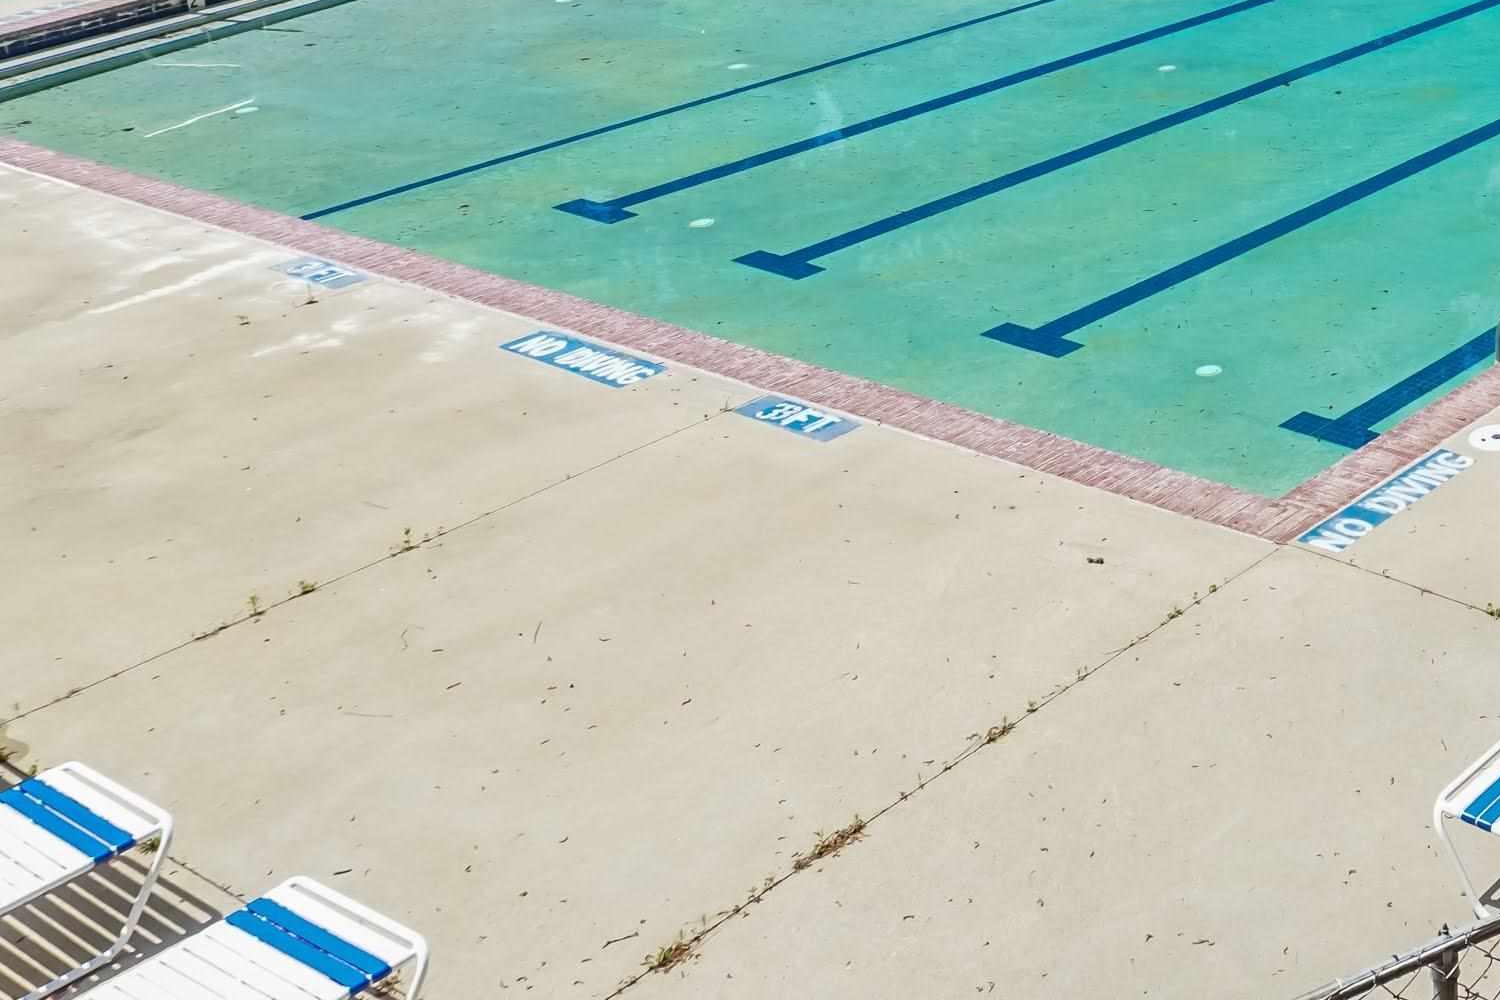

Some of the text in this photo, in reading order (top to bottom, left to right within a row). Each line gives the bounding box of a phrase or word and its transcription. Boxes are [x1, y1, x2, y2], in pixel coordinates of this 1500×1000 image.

[509, 334, 655, 385] NO DIVING
[1308, 452, 1474, 553] NO DIVING
